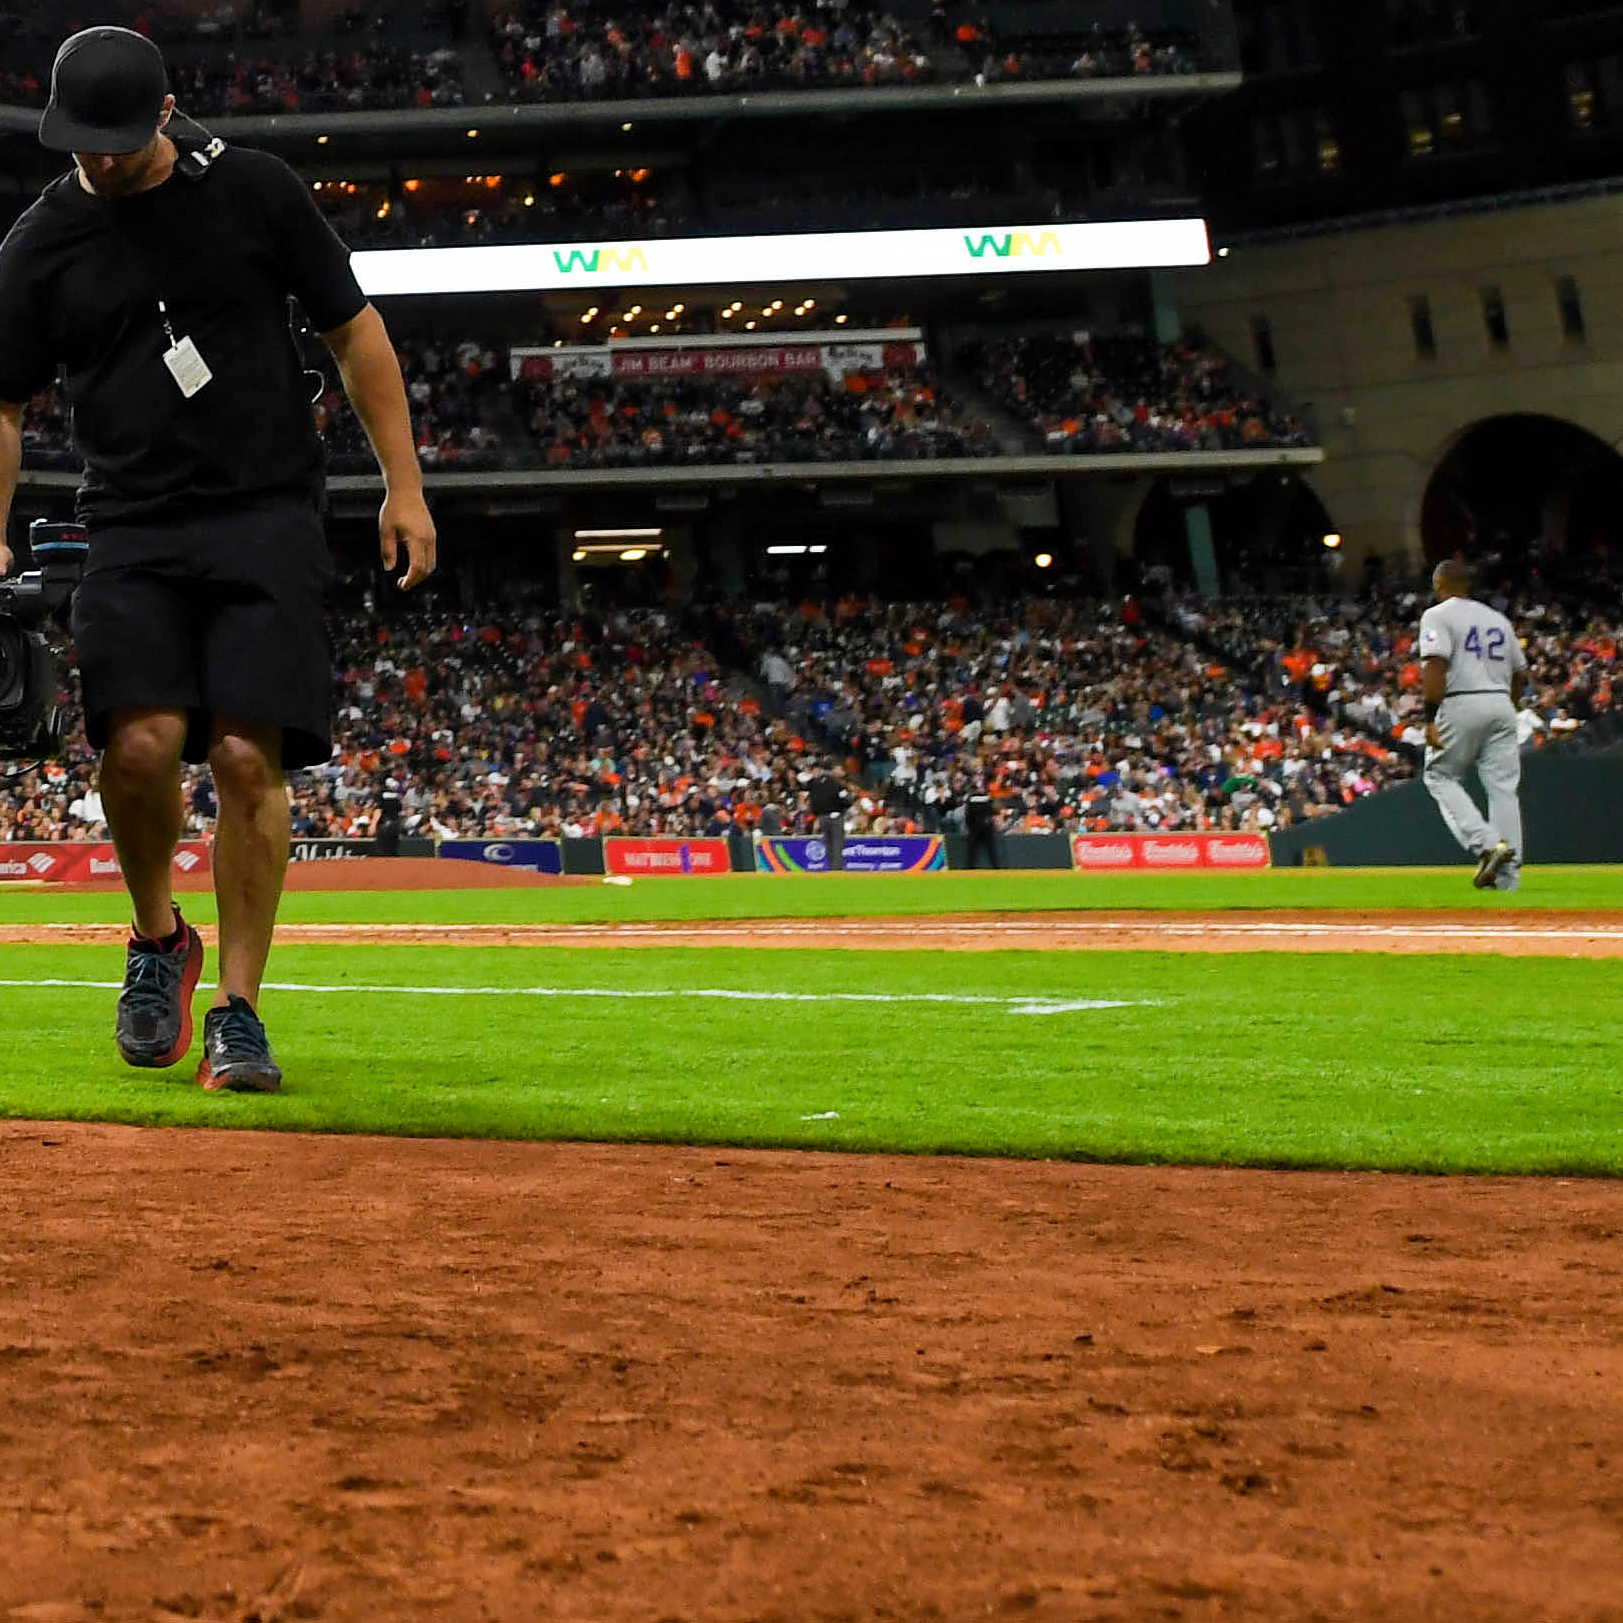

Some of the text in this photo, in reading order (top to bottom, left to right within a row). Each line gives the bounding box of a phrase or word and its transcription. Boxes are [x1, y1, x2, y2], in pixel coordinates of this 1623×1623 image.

[963, 232, 1063, 257] WM
[553, 248, 649, 273] WM
[1465, 626, 1506, 661] 42
